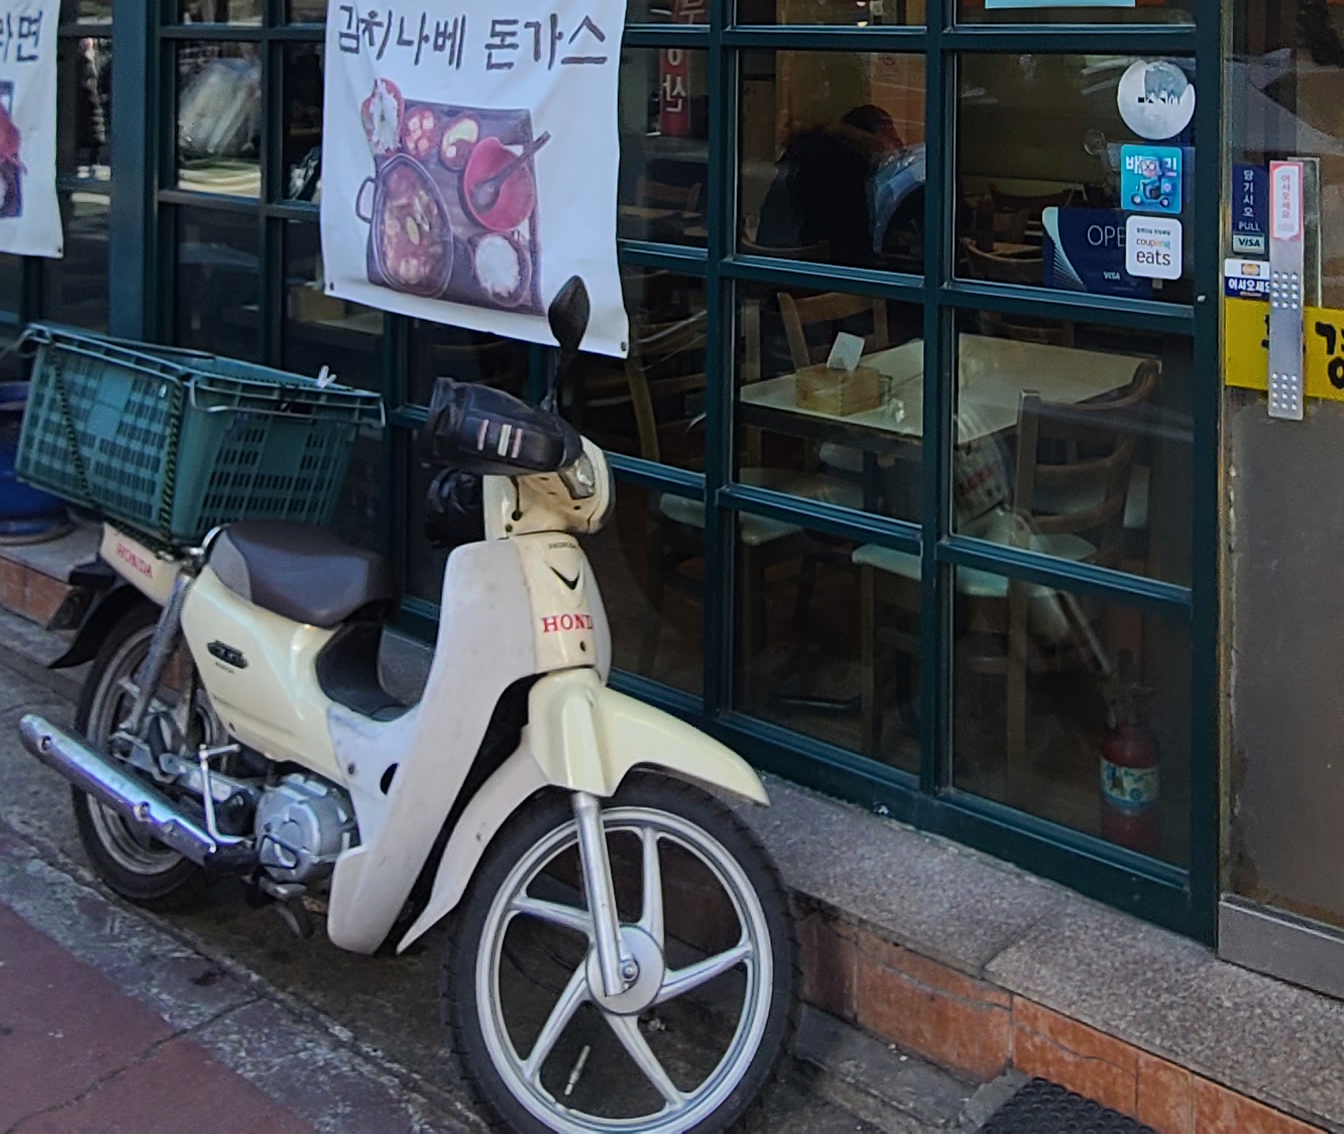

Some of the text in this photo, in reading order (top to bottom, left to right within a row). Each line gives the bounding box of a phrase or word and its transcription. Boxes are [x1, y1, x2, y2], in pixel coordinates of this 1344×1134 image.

[338, 5, 608, 71] 김치나베 돈가스
[1243, 169, 1255, 218] 당기시오
[1087, 224, 1126, 247] OPE
[1239, 221, 1260, 231] PULL
[1238, 237, 1261, 247] VISA
[1136, 250, 1171, 267] eats
[541, 614, 594, 633] HOND
